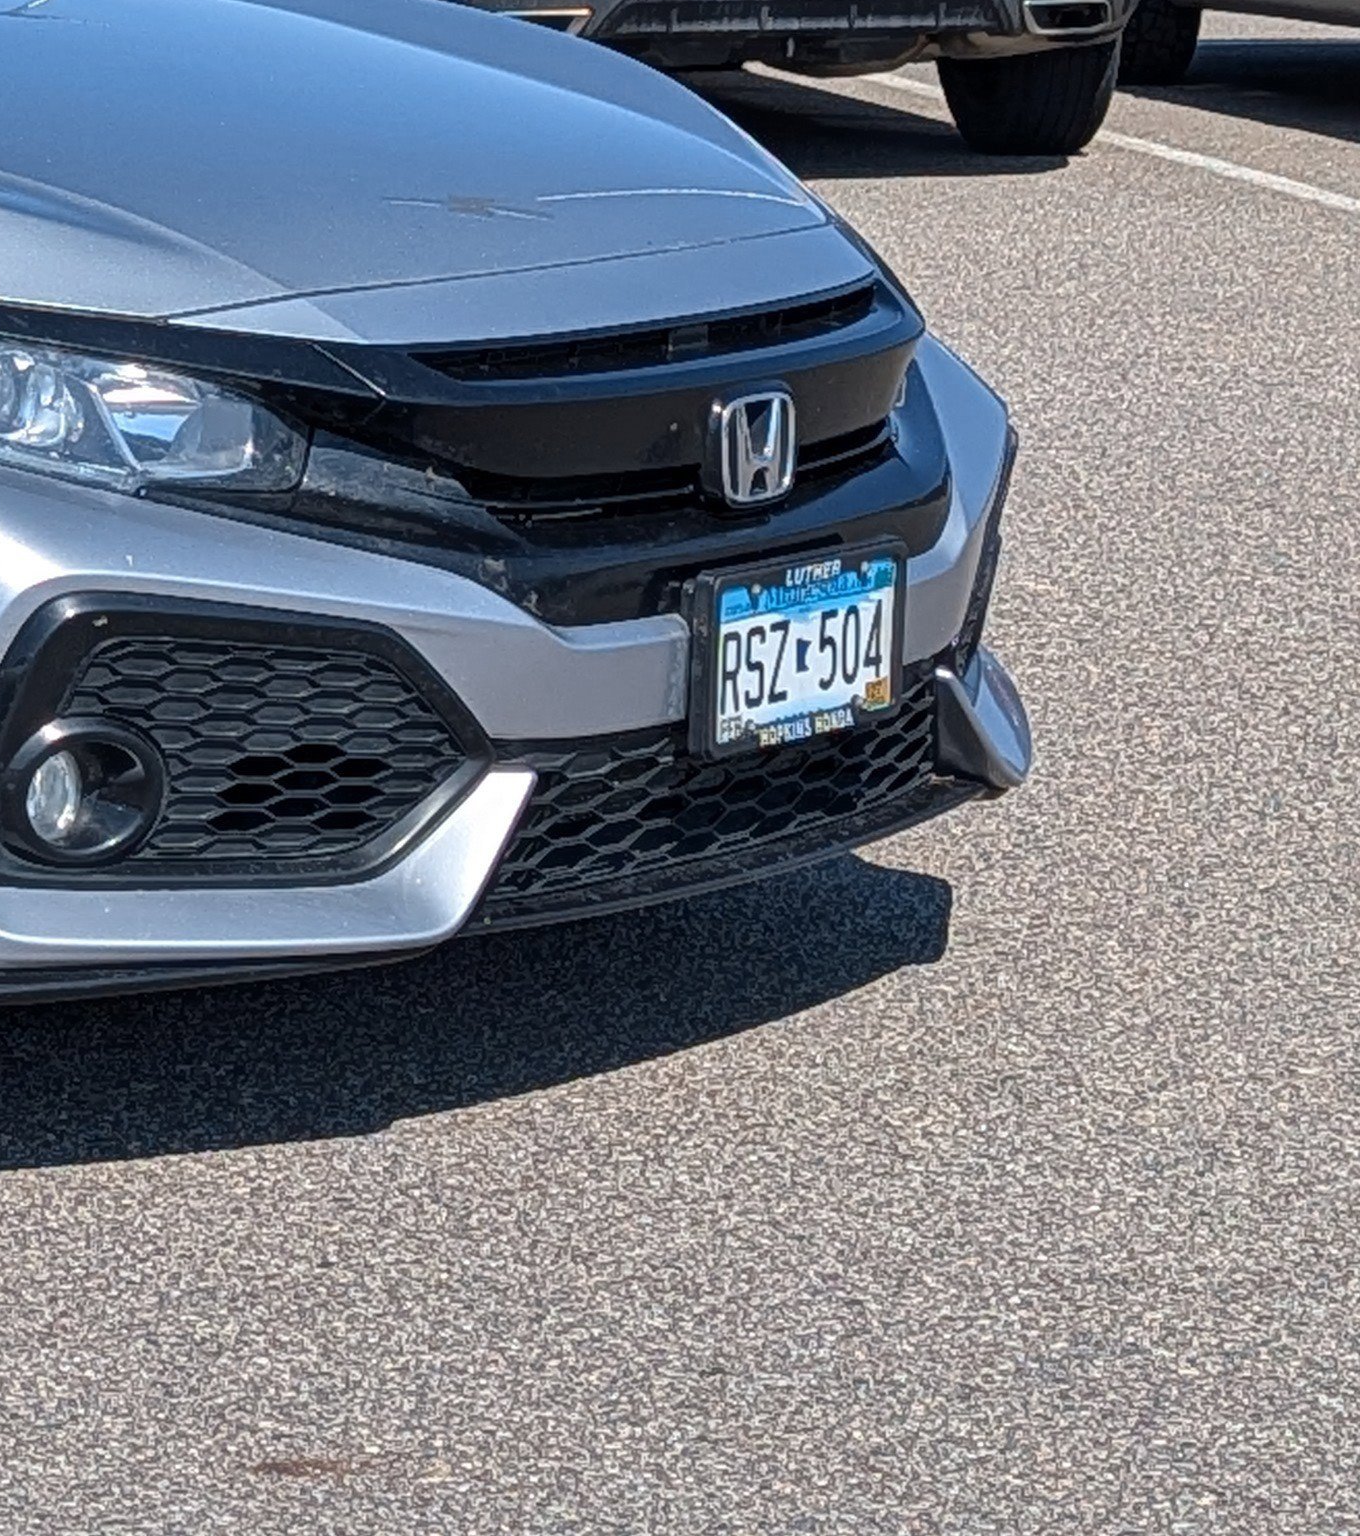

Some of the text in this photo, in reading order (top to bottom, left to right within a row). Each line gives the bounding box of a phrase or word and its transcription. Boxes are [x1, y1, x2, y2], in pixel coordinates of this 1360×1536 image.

[785, 559, 841, 587] LUTHER
[720, 598, 883, 715] RSZ 504
[758, 717, 812, 747] HOPKINS
[814, 708, 855, 733] HONDA
